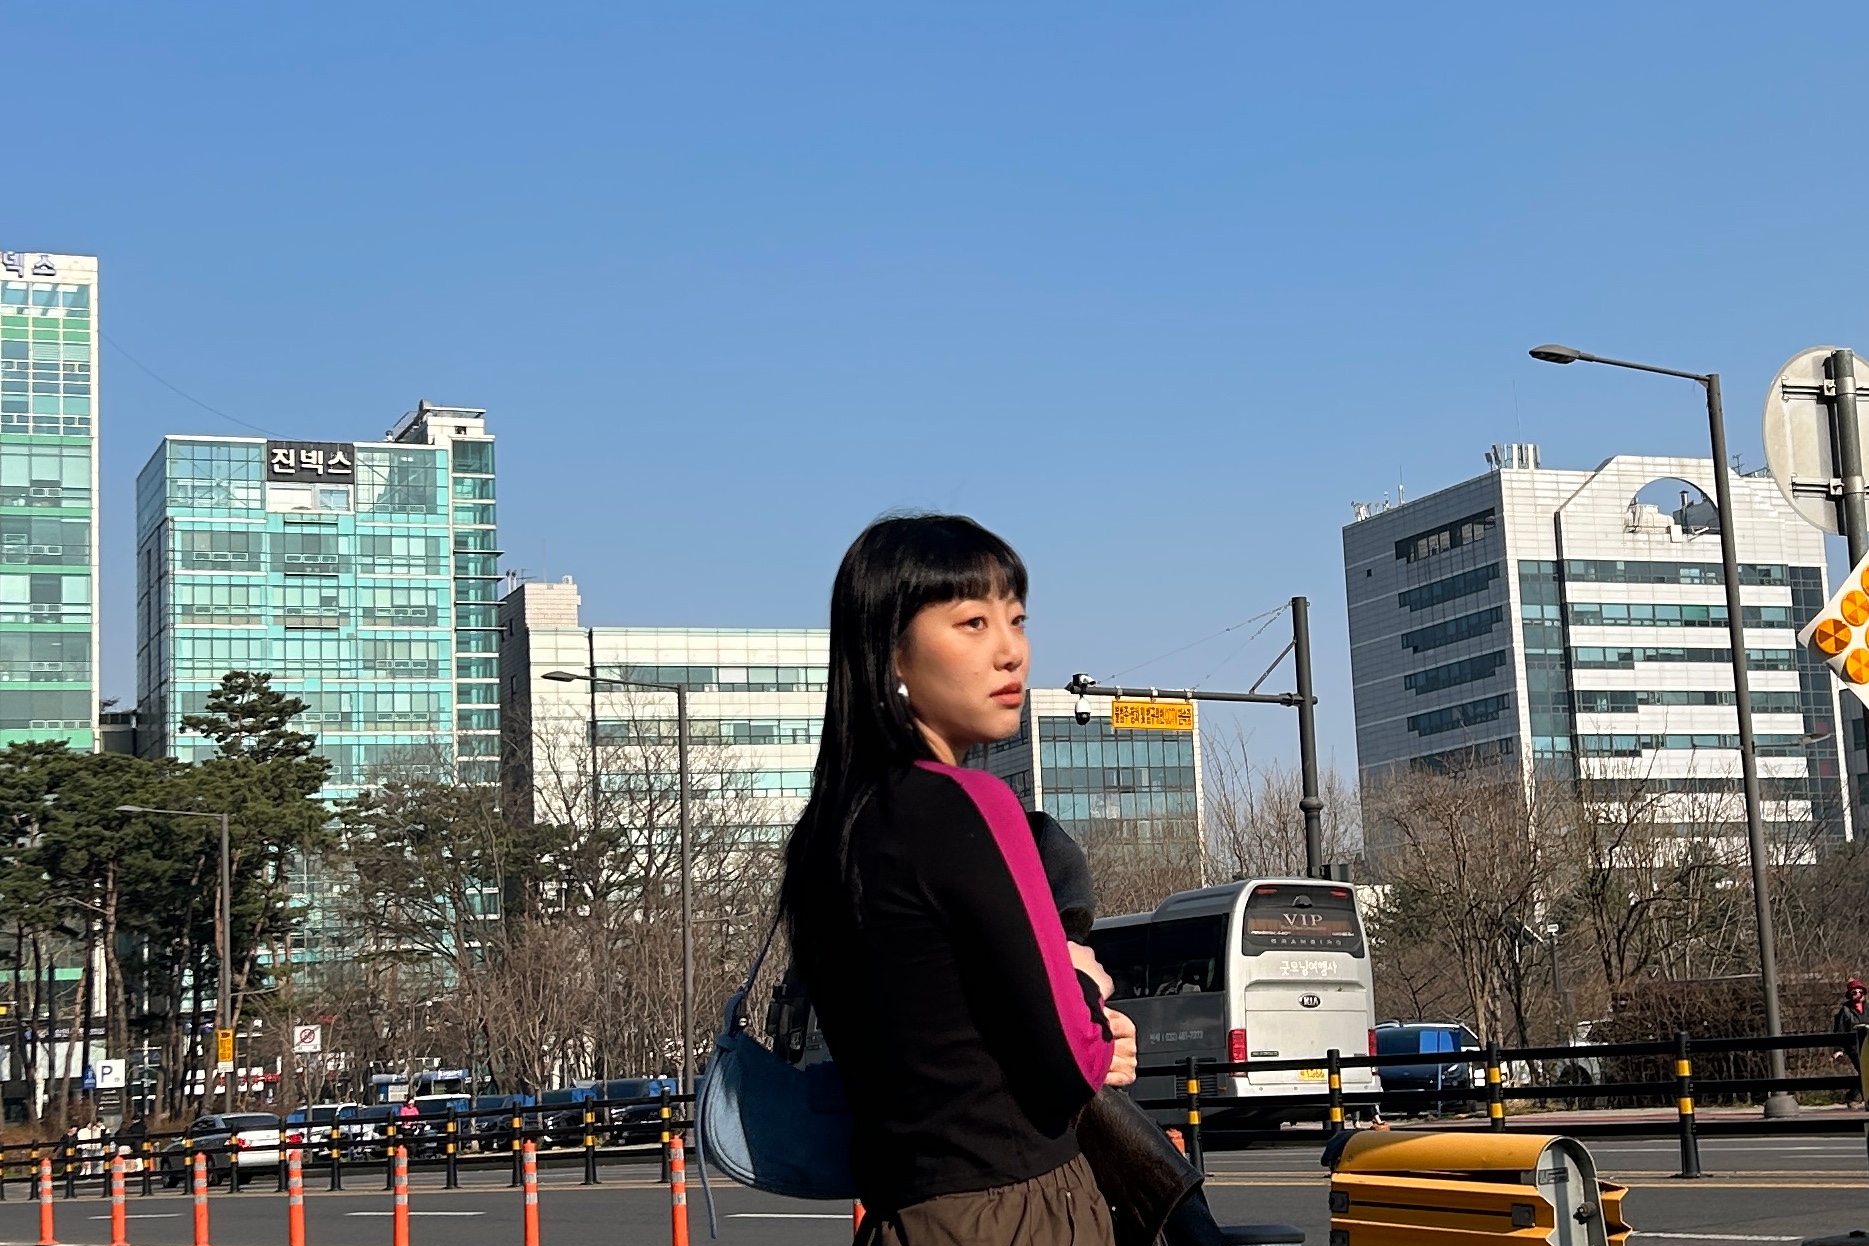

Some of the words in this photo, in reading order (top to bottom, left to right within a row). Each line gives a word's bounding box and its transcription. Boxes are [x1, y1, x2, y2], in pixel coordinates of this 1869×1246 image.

[271, 448, 352, 475] 진넥스
[1283, 913, 1323, 926] VIP
[1303, 996, 1319, 1006] KIA
[101, 1065, 113, 1083] P
